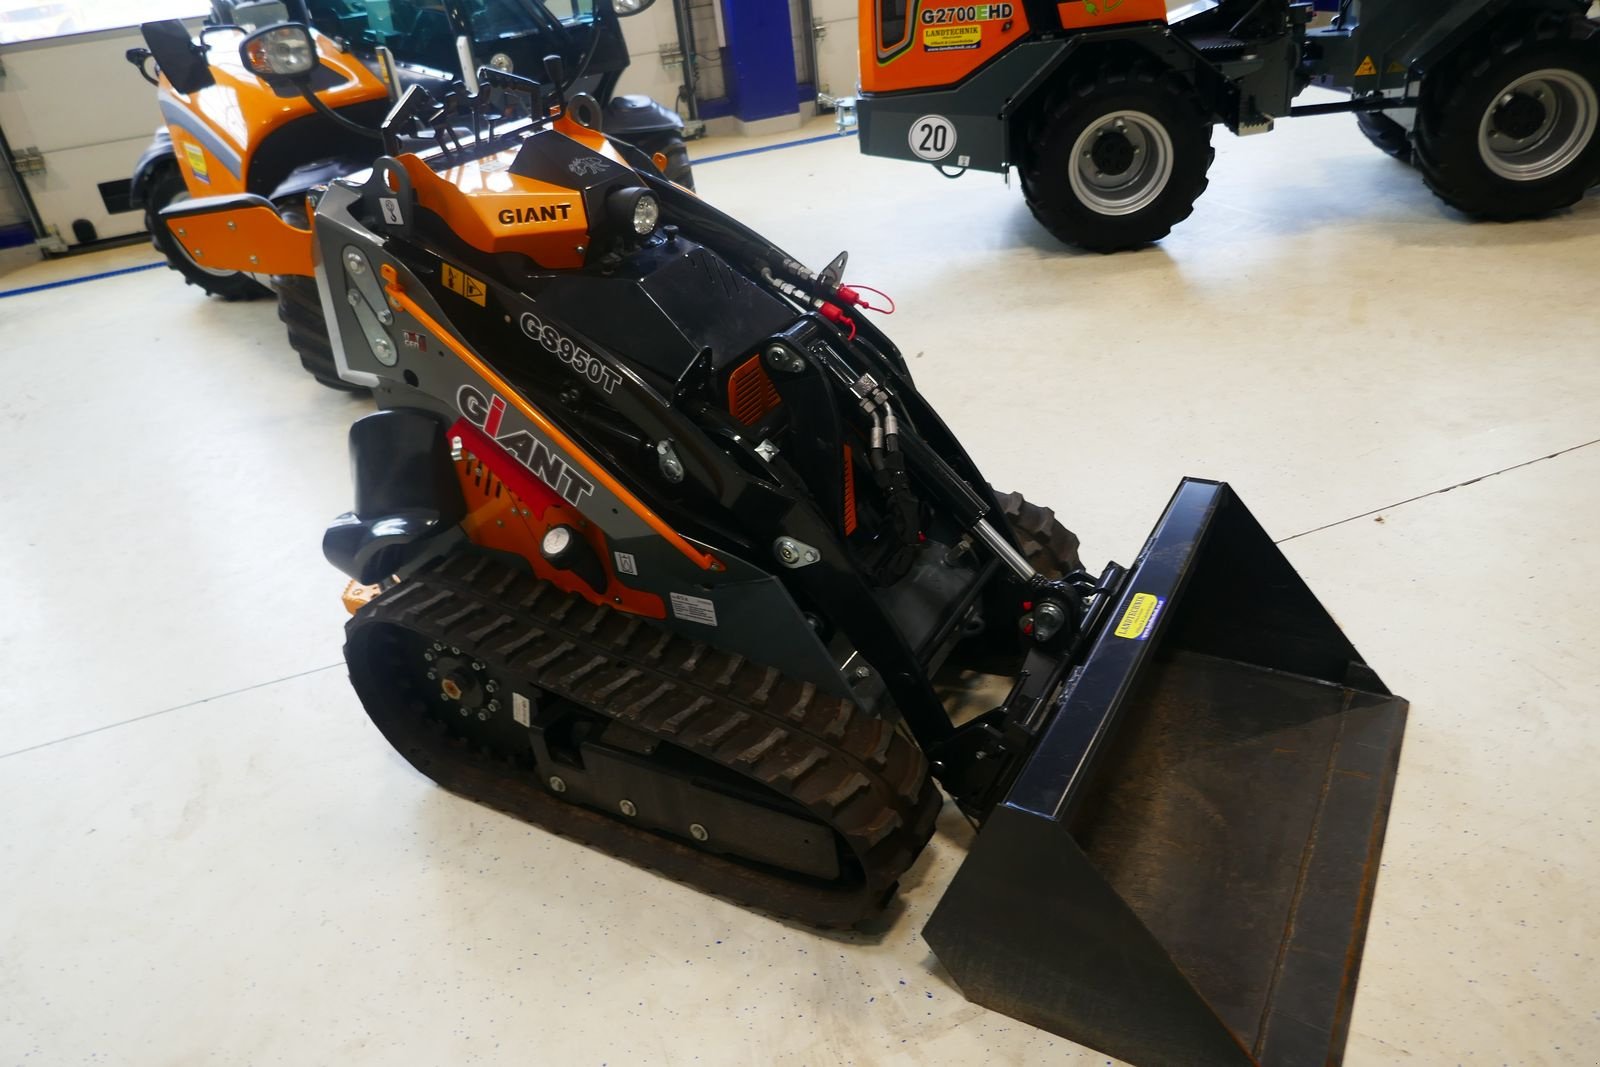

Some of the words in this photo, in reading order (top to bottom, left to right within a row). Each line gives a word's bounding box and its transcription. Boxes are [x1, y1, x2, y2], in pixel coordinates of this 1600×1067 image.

[921, 3, 1013, 25] G2700EHD
[925, 27, 978, 37] LANDTECHNIK
[919, 123, 947, 152] 20
[498, 203, 571, 225] GIANT
[520, 312, 623, 394] GS950T
